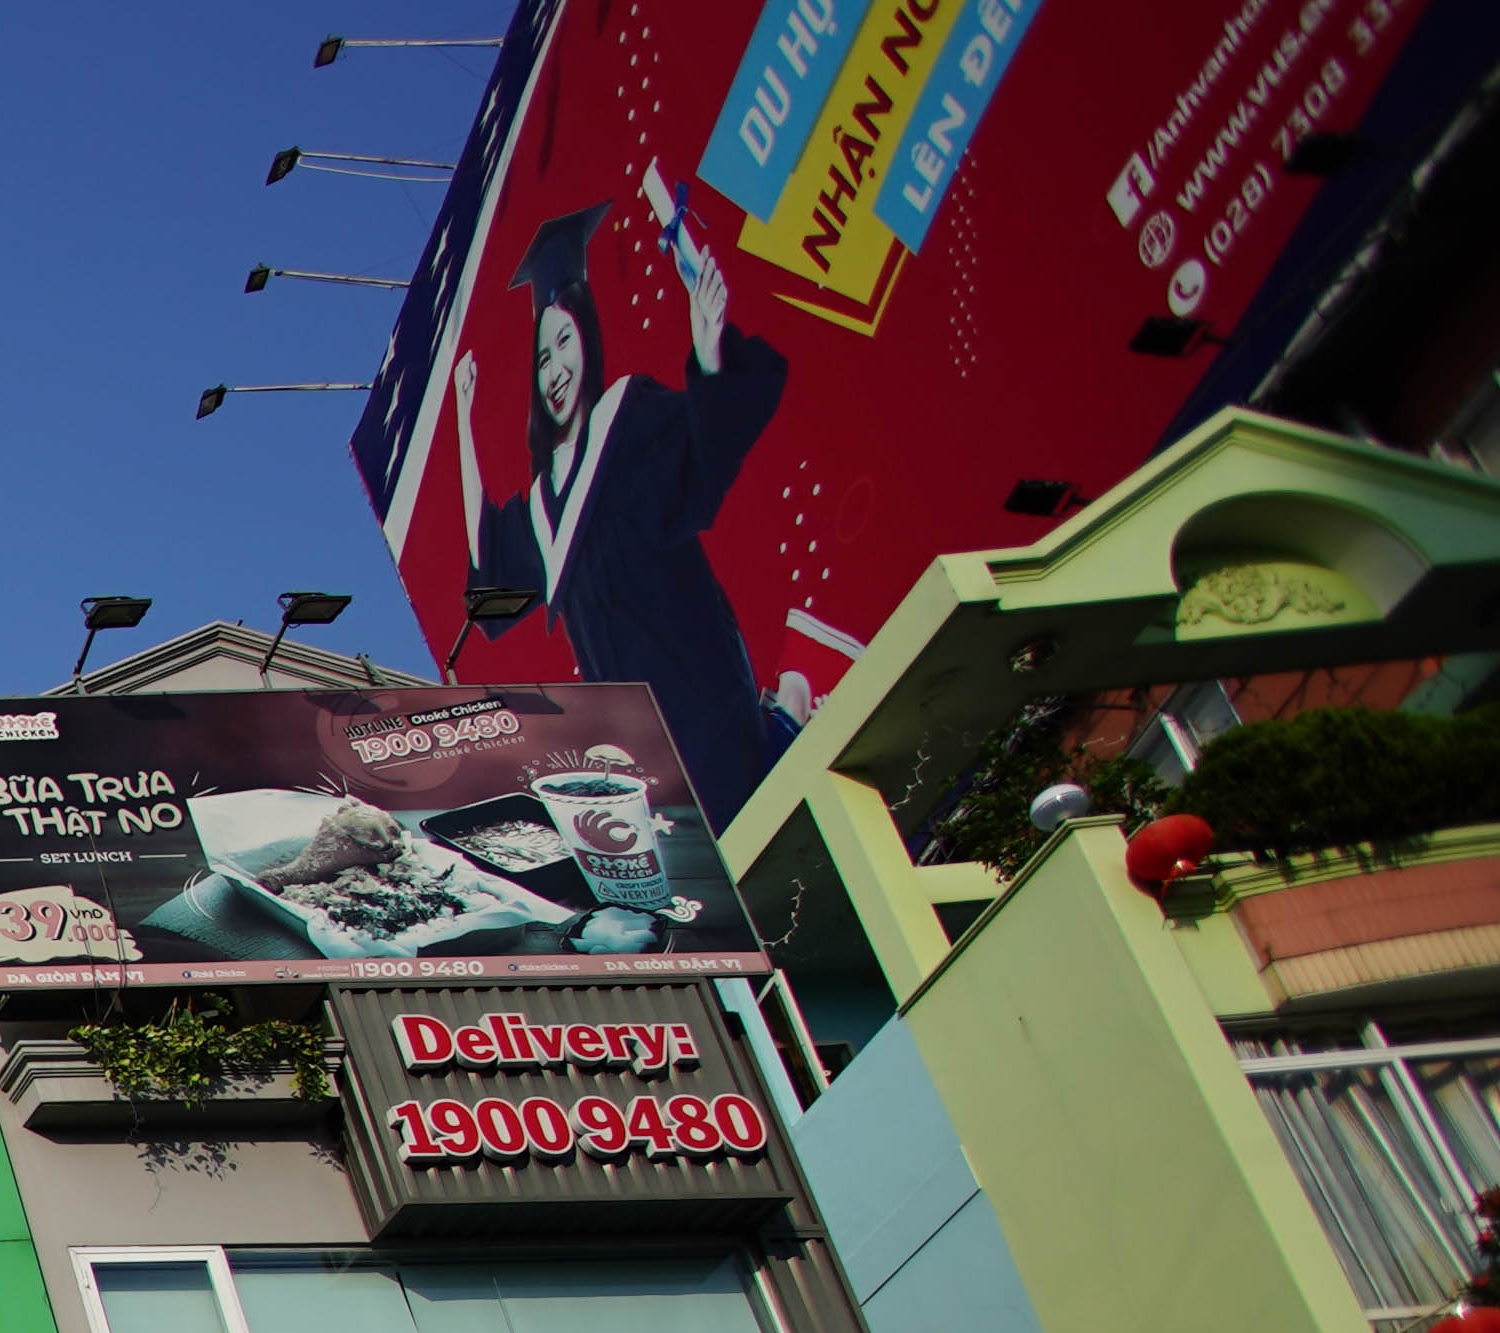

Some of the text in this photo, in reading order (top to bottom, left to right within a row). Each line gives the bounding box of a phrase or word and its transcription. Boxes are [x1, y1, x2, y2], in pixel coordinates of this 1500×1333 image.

[739, 66, 792, 168] DU
[801, 74, 894, 275] NHẬN
[902, 93, 968, 214] LÊN
[1204, 162, 1274, 266] (028)
[343, 717, 405, 740] HOTLINE
[450, 698, 502, 718] Chicken
[351, 709, 520, 764] 1900 9480
[474, 734, 526, 753] Chicken
[66, 771, 176, 804] TRƯA
[2, 802, 183, 838] THẬT NO
[40, 851, 133, 864] SET LUNCH
[592, 868, 653, 878] CHICKEN
[619, 887, 649, 901] VERY
[355, 961, 414, 978] 1900
[420, 960, 484, 977] 9480
[394, 1012, 700, 1076] Delivery:
[390, 1093, 768, 1163] 1900 9480
